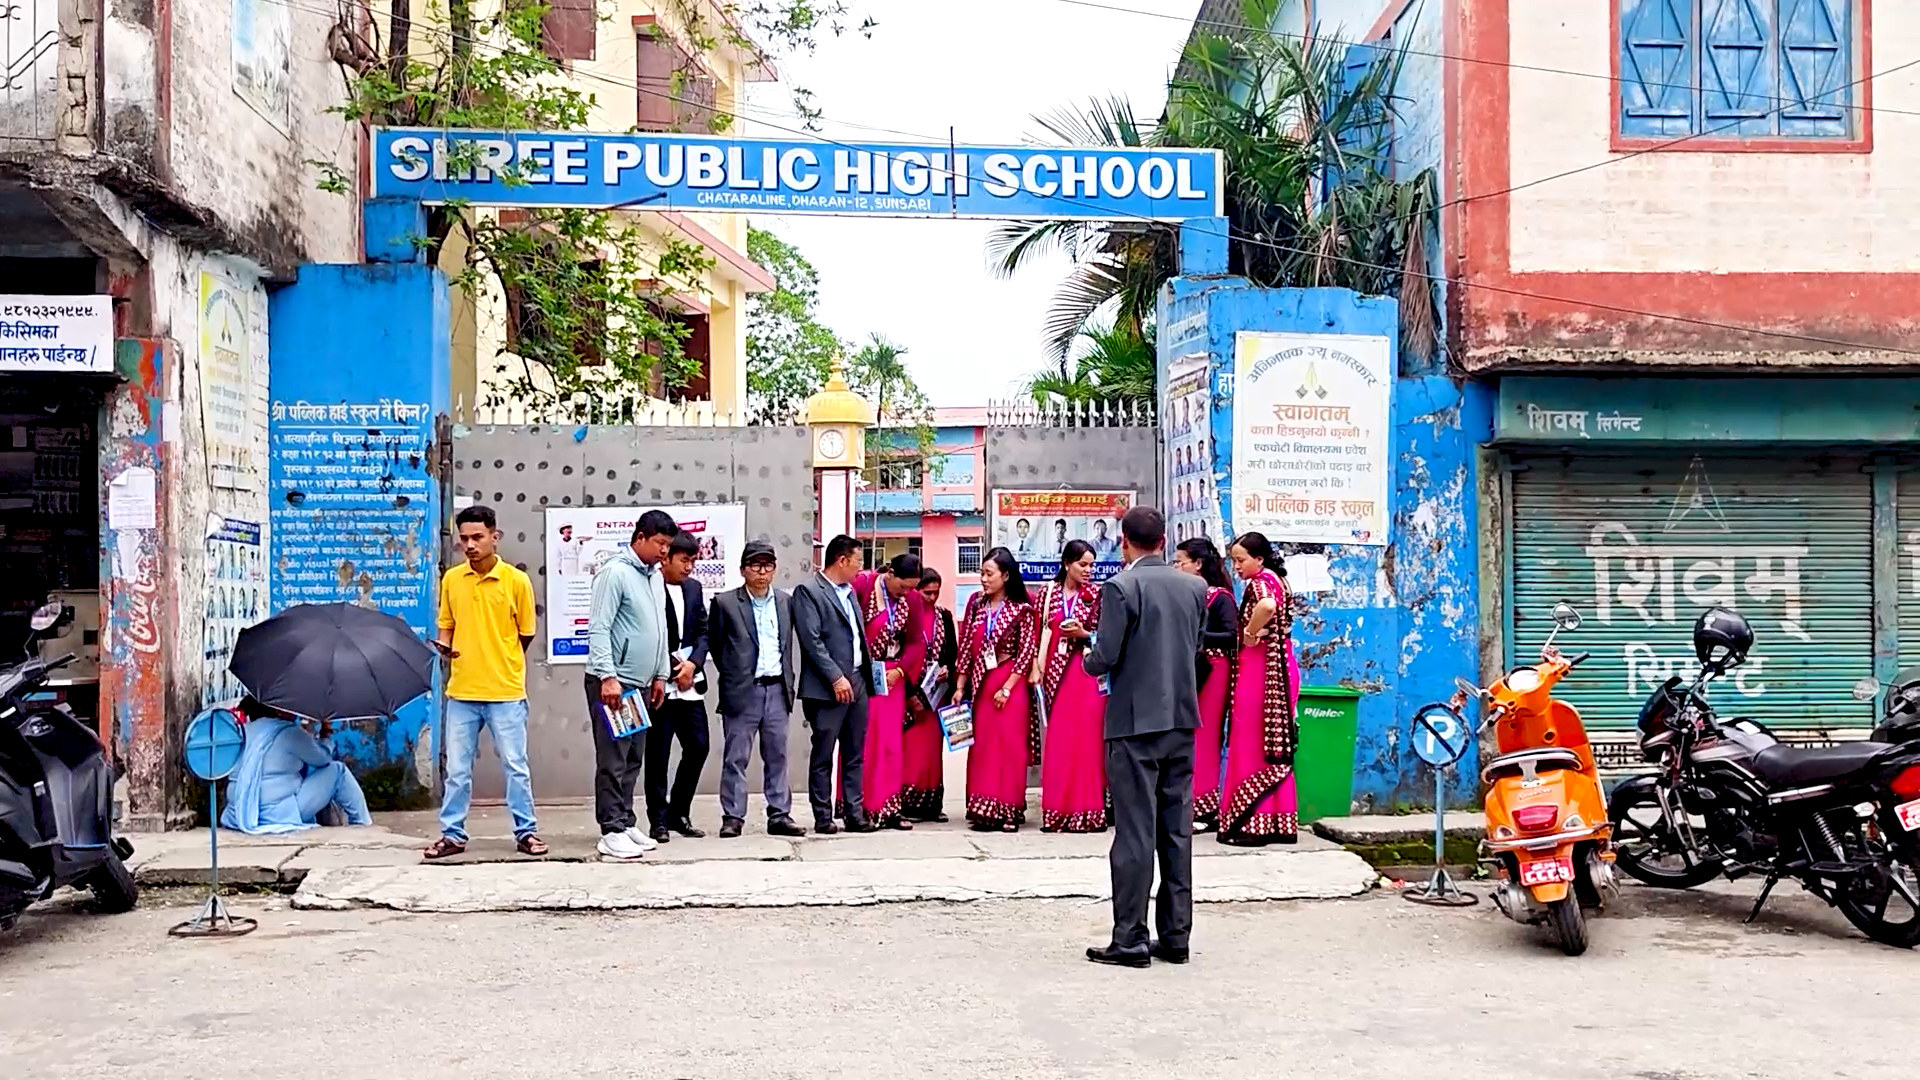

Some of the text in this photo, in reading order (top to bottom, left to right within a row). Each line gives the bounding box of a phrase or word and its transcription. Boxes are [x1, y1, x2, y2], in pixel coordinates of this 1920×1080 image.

[389, 137, 1207, 200] SHREE PUBLIC HIGH SCHOOL
[1330, 349, 1379, 388] नमस्कार
[271, 399, 286, 422] श्री
[289, 399, 327, 423] पब्लिक
[1272, 404, 1351, 425] स्वागतम्
[1527, 403, 1591, 439] शिवम्
[1019, 493, 1067, 506] हार्दिक
[1244, 493, 1261, 514] श्री
[1266, 493, 1310, 514] पब्लिक
[1018, 562, 1122, 574] PUBLIC SCHOO
[1585, 520, 1809, 642] शिवम्
